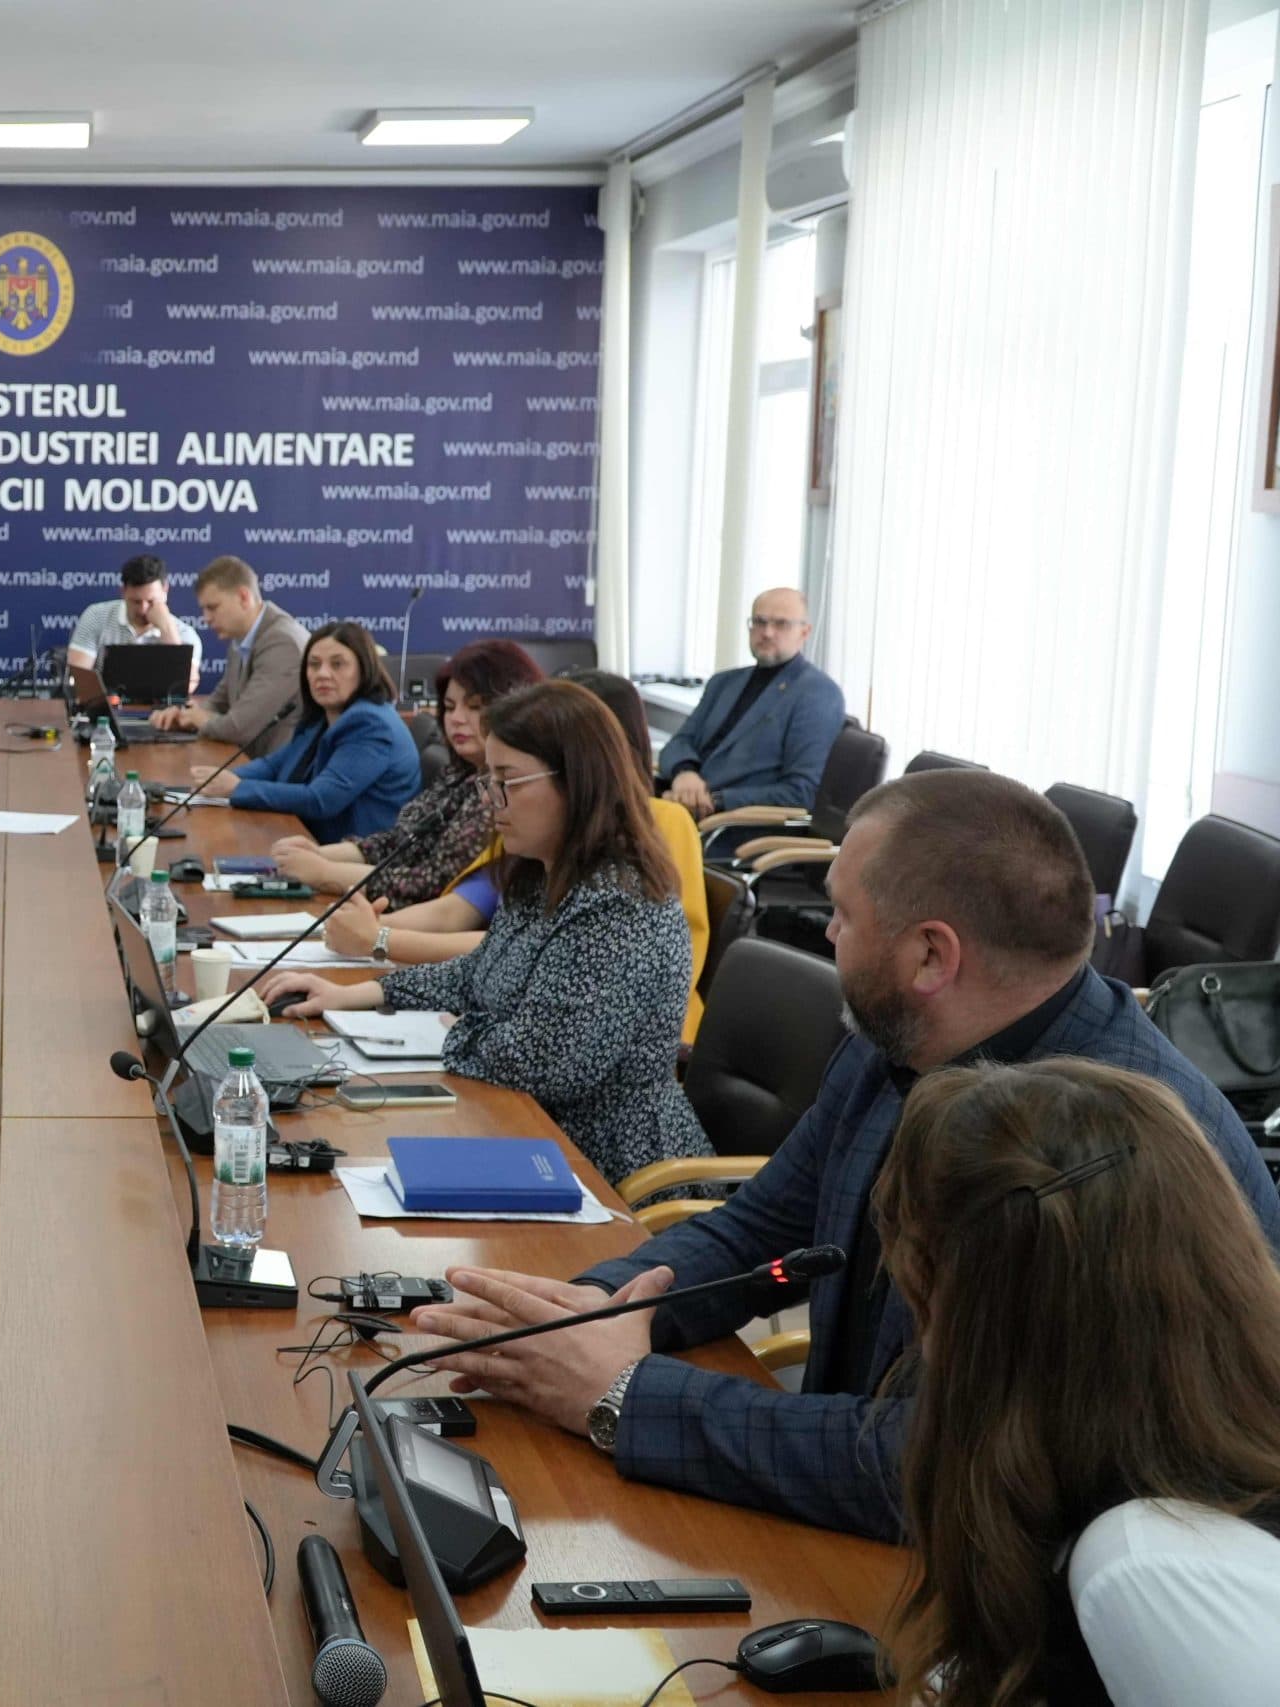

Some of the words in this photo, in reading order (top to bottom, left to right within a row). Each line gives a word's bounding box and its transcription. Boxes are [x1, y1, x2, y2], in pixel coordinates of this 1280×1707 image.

[171, 208, 345, 231] www.maia.gov.md
[377, 209, 550, 232] www.maia.gov.md
[253, 256, 424, 279] www.maia.gov.md
[457, 255, 605, 279] www.maia.gov.
[167, 300, 338, 324] www.maia.gov.md
[371, 302, 542, 325] www.maia.gov.md
[249, 347, 419, 370] www.maia.gov.md
[452, 346, 601, 371] www.maia.gov.
[322, 393, 492, 415] www.maia.gov.md
[177, 432, 414, 466] ALIMENTARE
[442, 436, 601, 461] www.maia.gov.m
[65, 479, 257, 512] MOLDOVA
[322, 481, 491, 504] www.maia.gov.md
[43, 524, 211, 546] www.maia.gov.md
[245, 525, 413, 547] www.maia.gov.md
[363, 570, 531, 592] www.maia.gov.md
